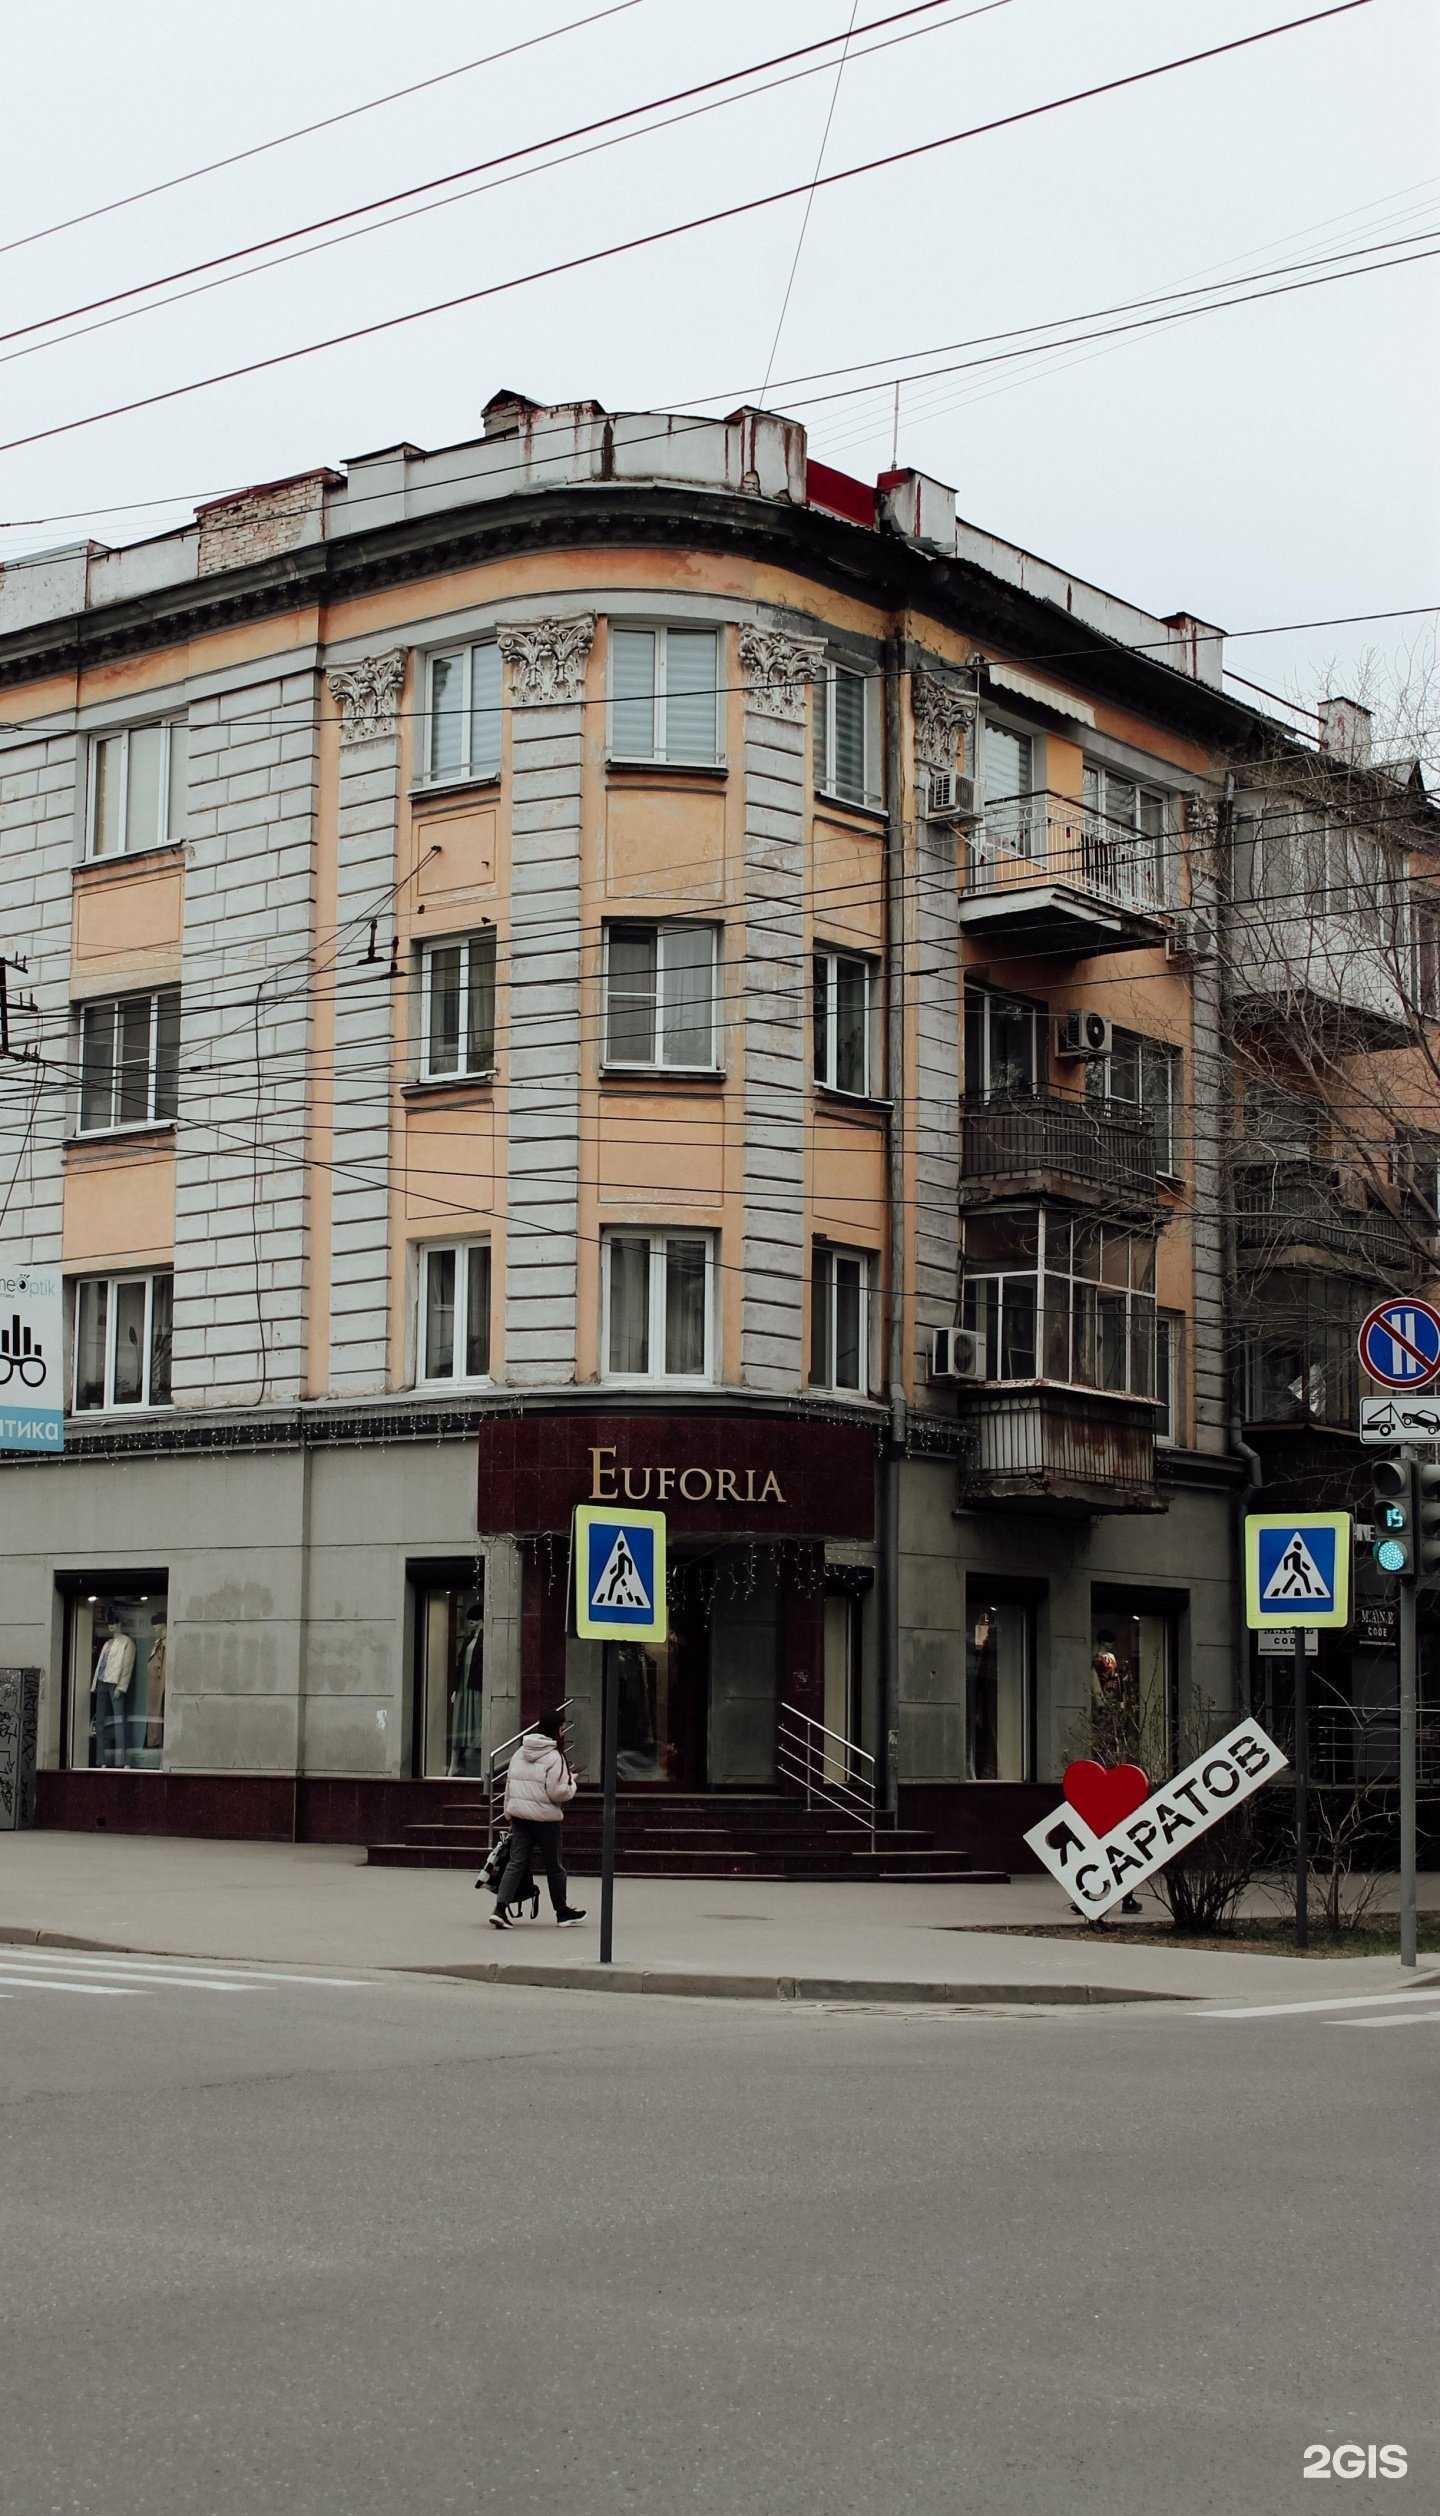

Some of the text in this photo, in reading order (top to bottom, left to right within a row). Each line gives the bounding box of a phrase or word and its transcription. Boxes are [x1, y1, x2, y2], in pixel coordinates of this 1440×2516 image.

[1386, 1508, 1403, 1527] 15
[1274, 1637, 1296, 1645] COD
[1368, 1627, 1388, 1637] CODE
[1075, 1735, 1271, 1902] САРАТОВ
[1045, 1821, 1086, 1867] Я
